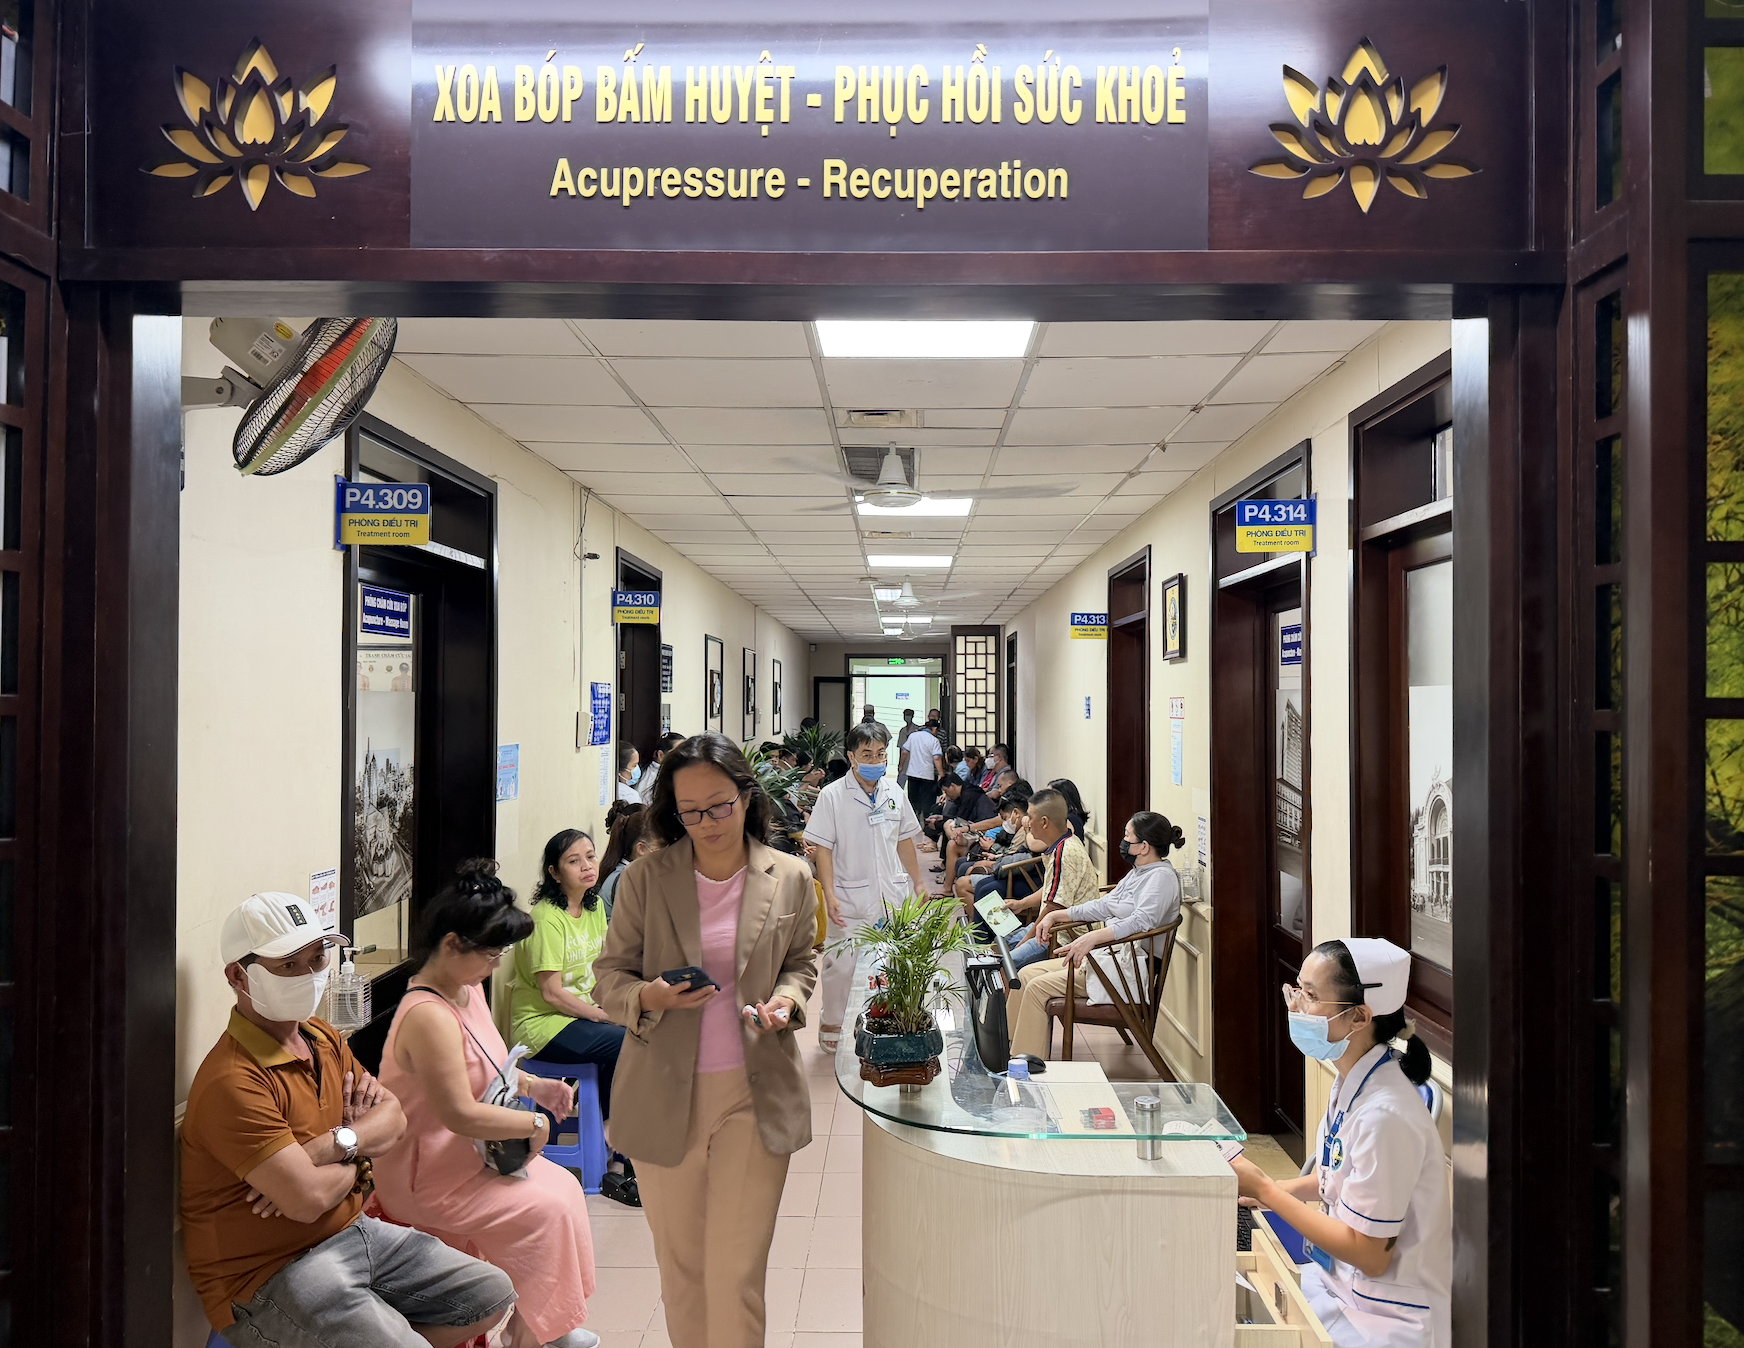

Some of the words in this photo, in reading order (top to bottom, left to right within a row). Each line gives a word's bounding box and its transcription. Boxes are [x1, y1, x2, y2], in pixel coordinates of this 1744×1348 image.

[433, 64, 502, 122] XOA
[514, 50, 584, 122] BÓP
[595, 42, 672, 123] BẤM
[685, 50, 795, 136] HUYỆT
[806, 93, 822, 107] -
[834, 64, 929, 137] PHỤC
[942, 43, 1000, 123] HỒI
[1013, 50, 1082, 124] SỨC
[1095, 47, 1186, 124] KHOẺ
[550, 158, 785, 207] Acupressure
[797, 178, 810, 187] -
[823, 158, 1068, 209] Recuperation
[345, 488, 422, 509] P4.309
[1244, 504, 1307, 523] P4.314
[348, 517, 380, 527] PHÒNG
[404, 519, 418, 528] TRỊ
[357, 530, 391, 538] Treatment
[1246, 529, 1273, 538] PHÒNG
[616, 594, 655, 605] P4.310
[1075, 615, 1105, 624] P4.313
